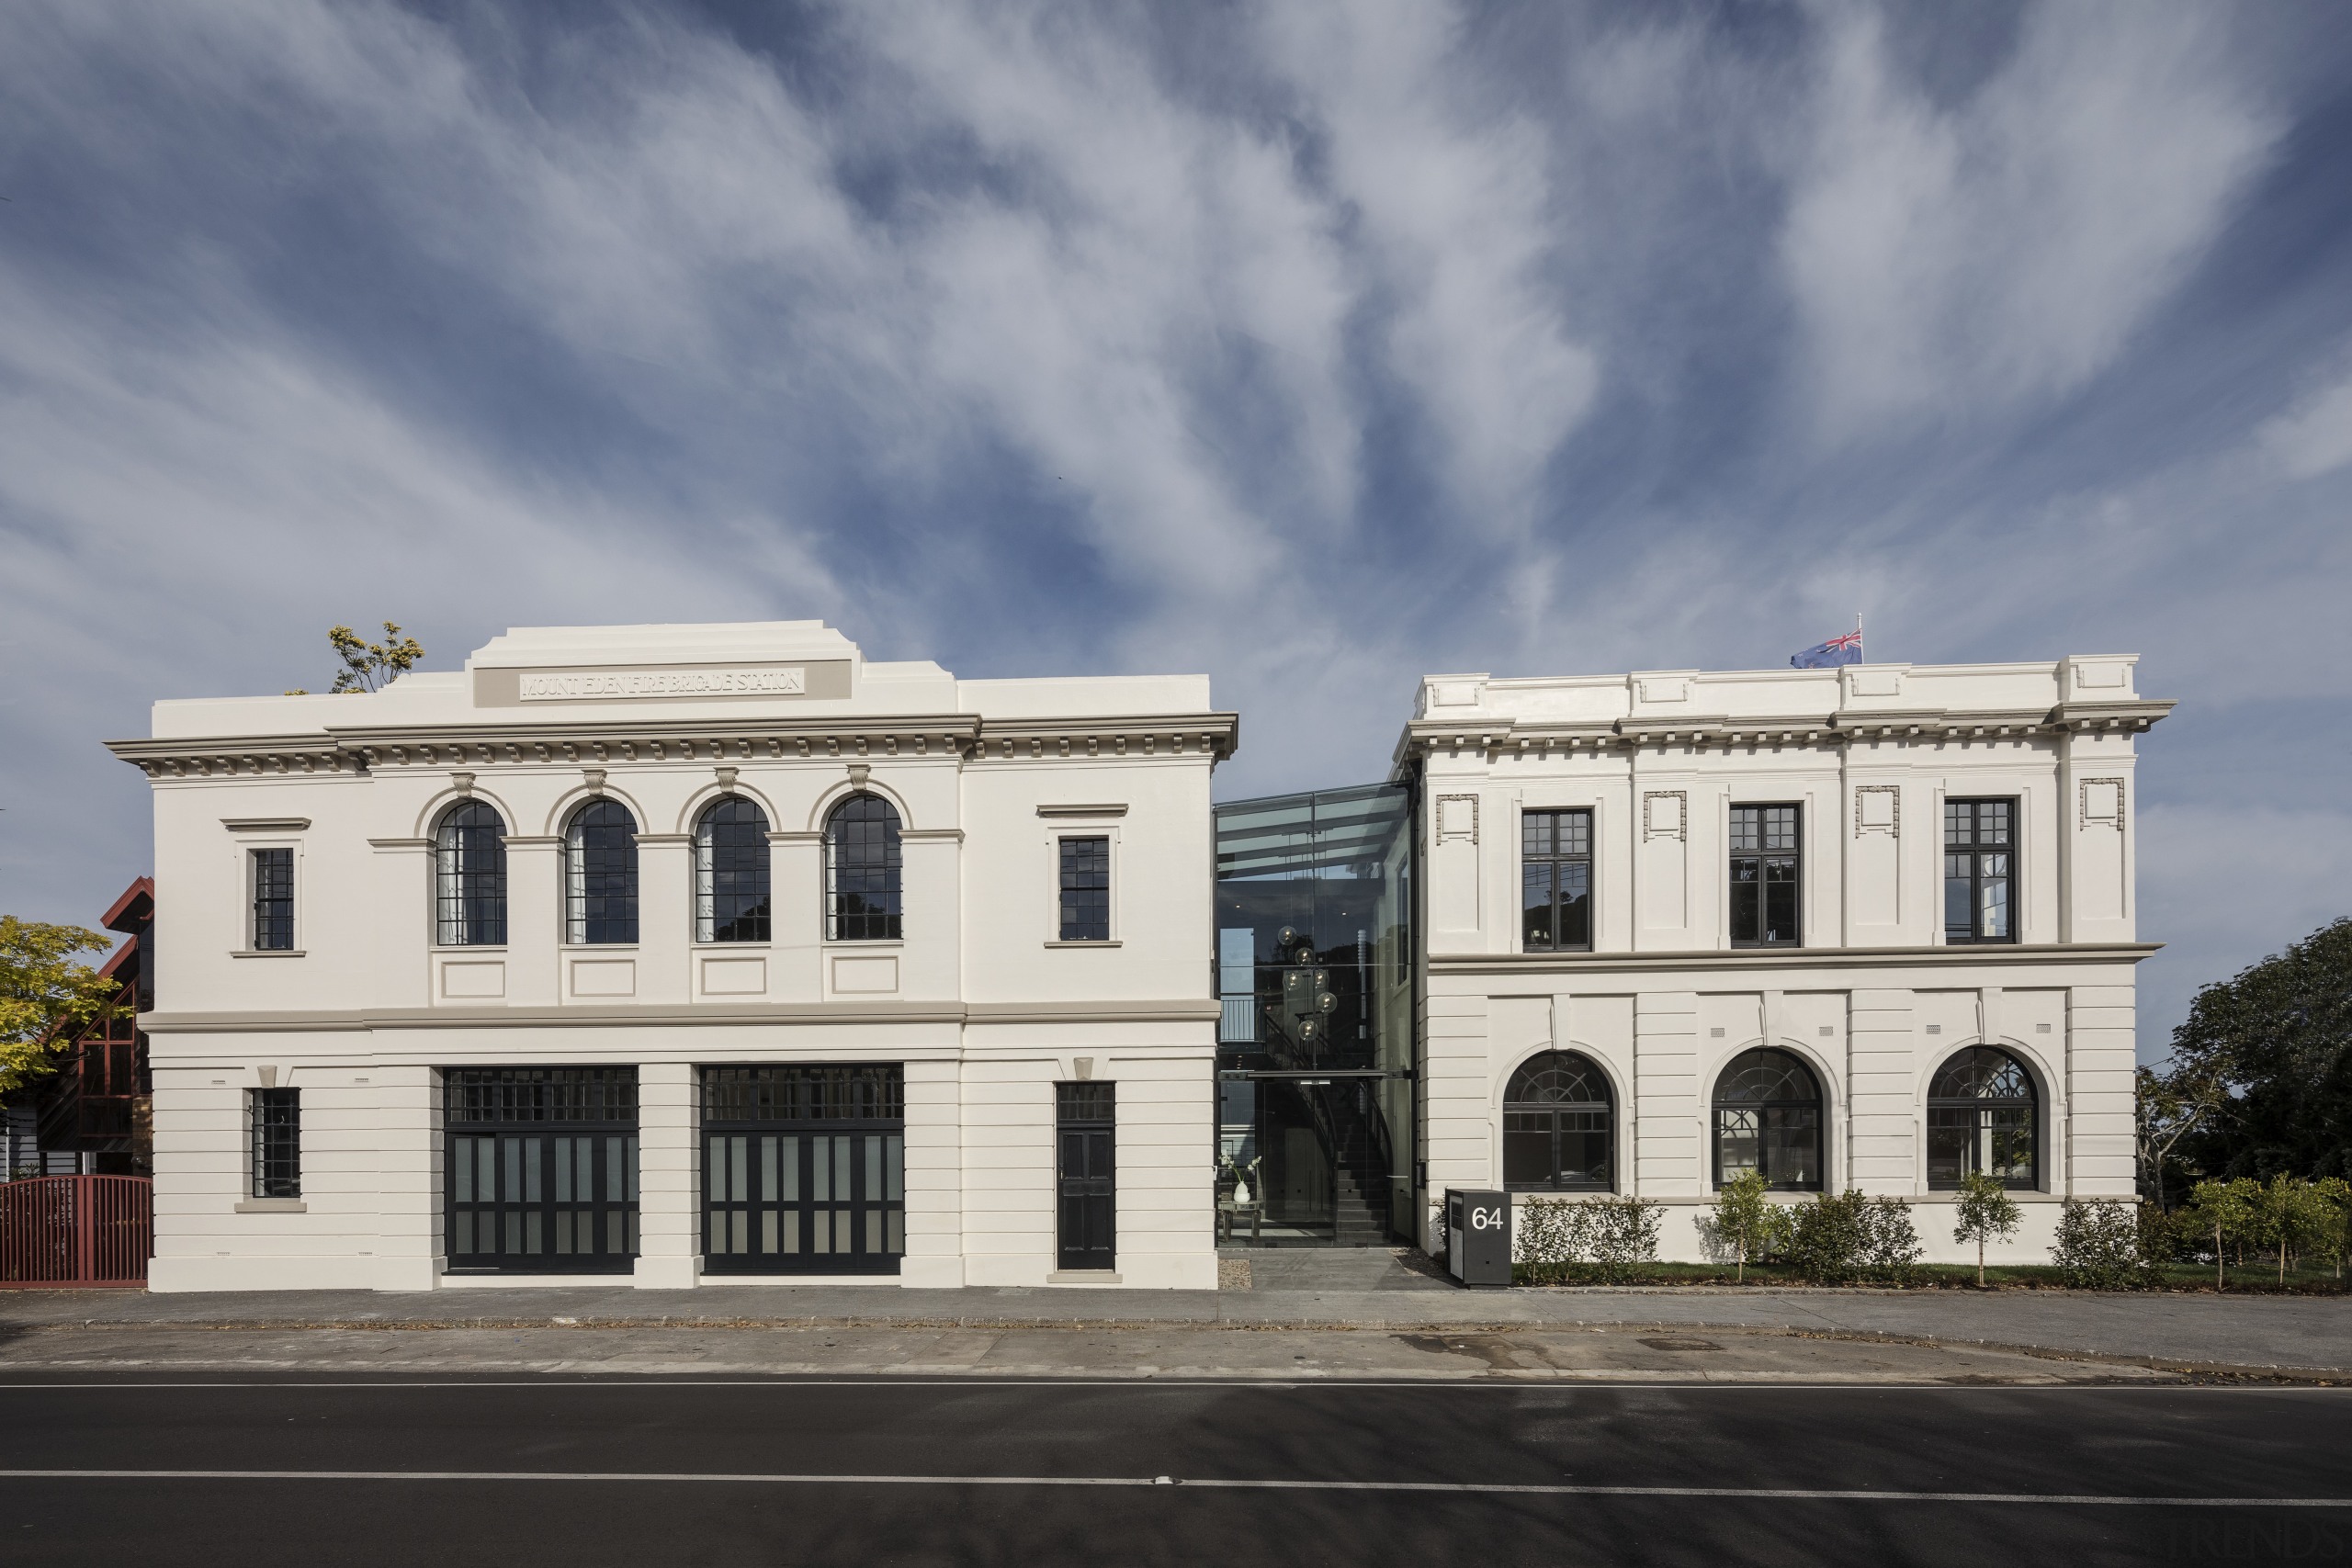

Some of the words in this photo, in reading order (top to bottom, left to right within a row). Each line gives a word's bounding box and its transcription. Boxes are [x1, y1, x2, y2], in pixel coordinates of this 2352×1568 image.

[522, 676, 578, 695] MOUNT
[581, 675, 627, 694] EDEN
[628, 675, 667, 694] FIRE
[668, 673, 733, 693] BRIGADE
[737, 671, 800, 691] STATION
[1472, 1207, 1504, 1230] 64
